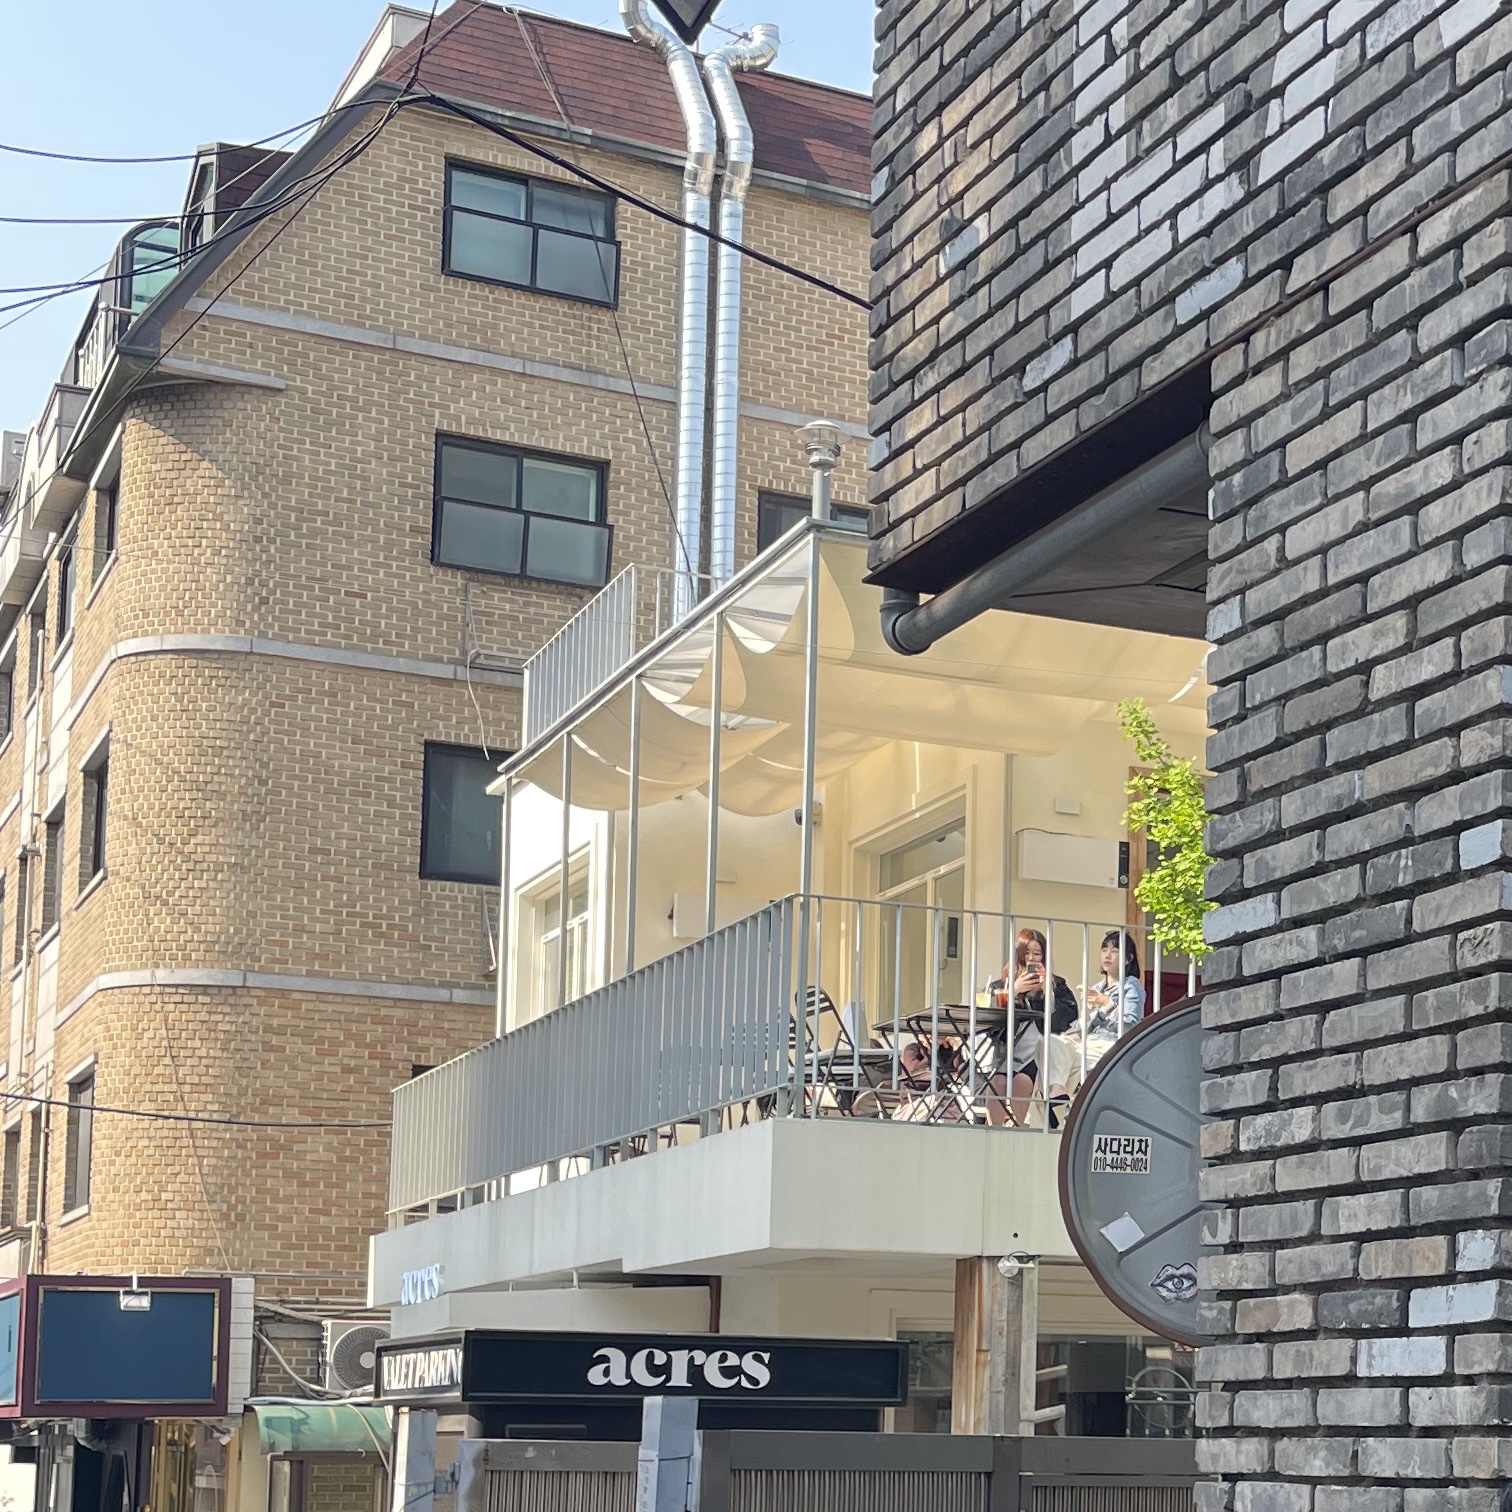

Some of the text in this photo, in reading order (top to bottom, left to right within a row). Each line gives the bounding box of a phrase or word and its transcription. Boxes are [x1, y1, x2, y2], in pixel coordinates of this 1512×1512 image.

[1095, 1137, 1149, 1156] 사다리차
[401, 1263, 440, 1305] acres
[383, 1353, 417, 1390] VALET
[587, 1347, 771, 1389] acres
